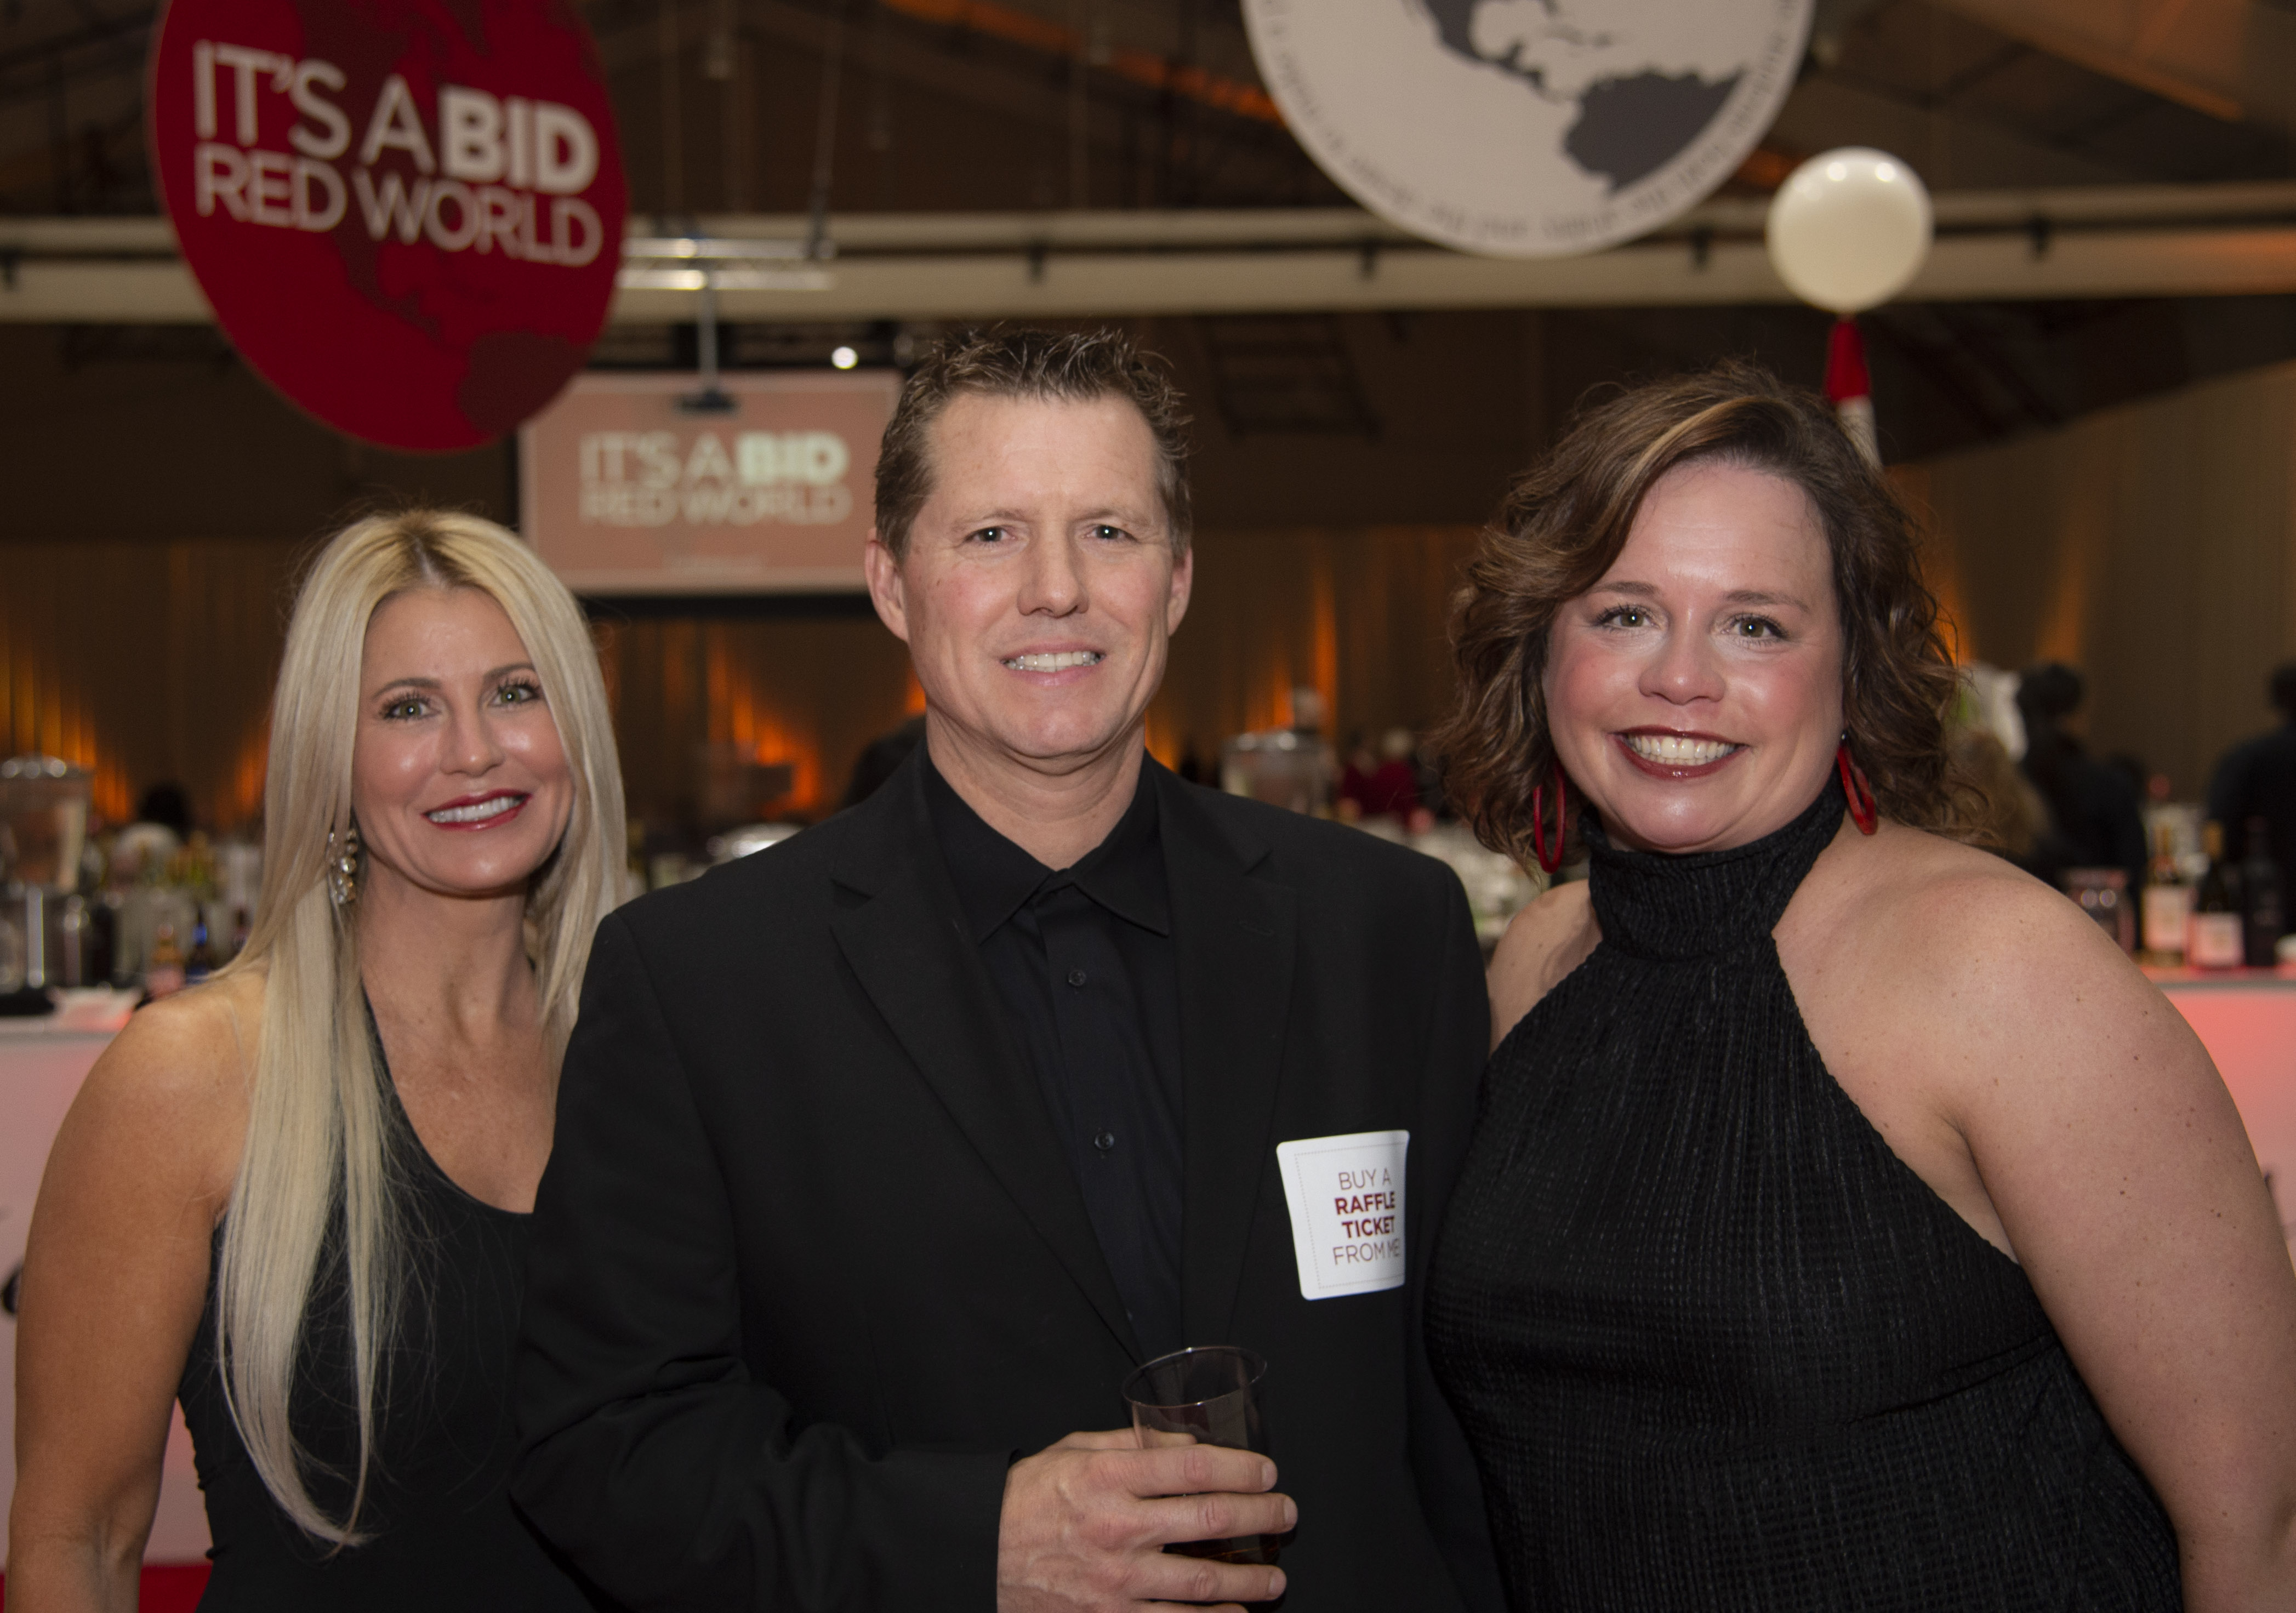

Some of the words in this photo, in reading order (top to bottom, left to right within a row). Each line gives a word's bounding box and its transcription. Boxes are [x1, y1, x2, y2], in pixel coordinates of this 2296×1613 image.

[191, 37, 353, 161] IT'S
[357, 73, 437, 176] A
[440, 84, 601, 197] BID
[192, 143, 349, 233] RED
[351, 166, 605, 269] WORLD
[683, 433, 736, 491] A
[737, 430, 850, 485] BID
[1338, 1168, 1377, 1190] BUY
[1382, 1167, 1392, 1185] A
[1334, 1191, 1396, 1216] RAFFLE
[1341, 1215, 1395, 1239] TICKET
[1332, 1241, 1387, 1266] FROM
